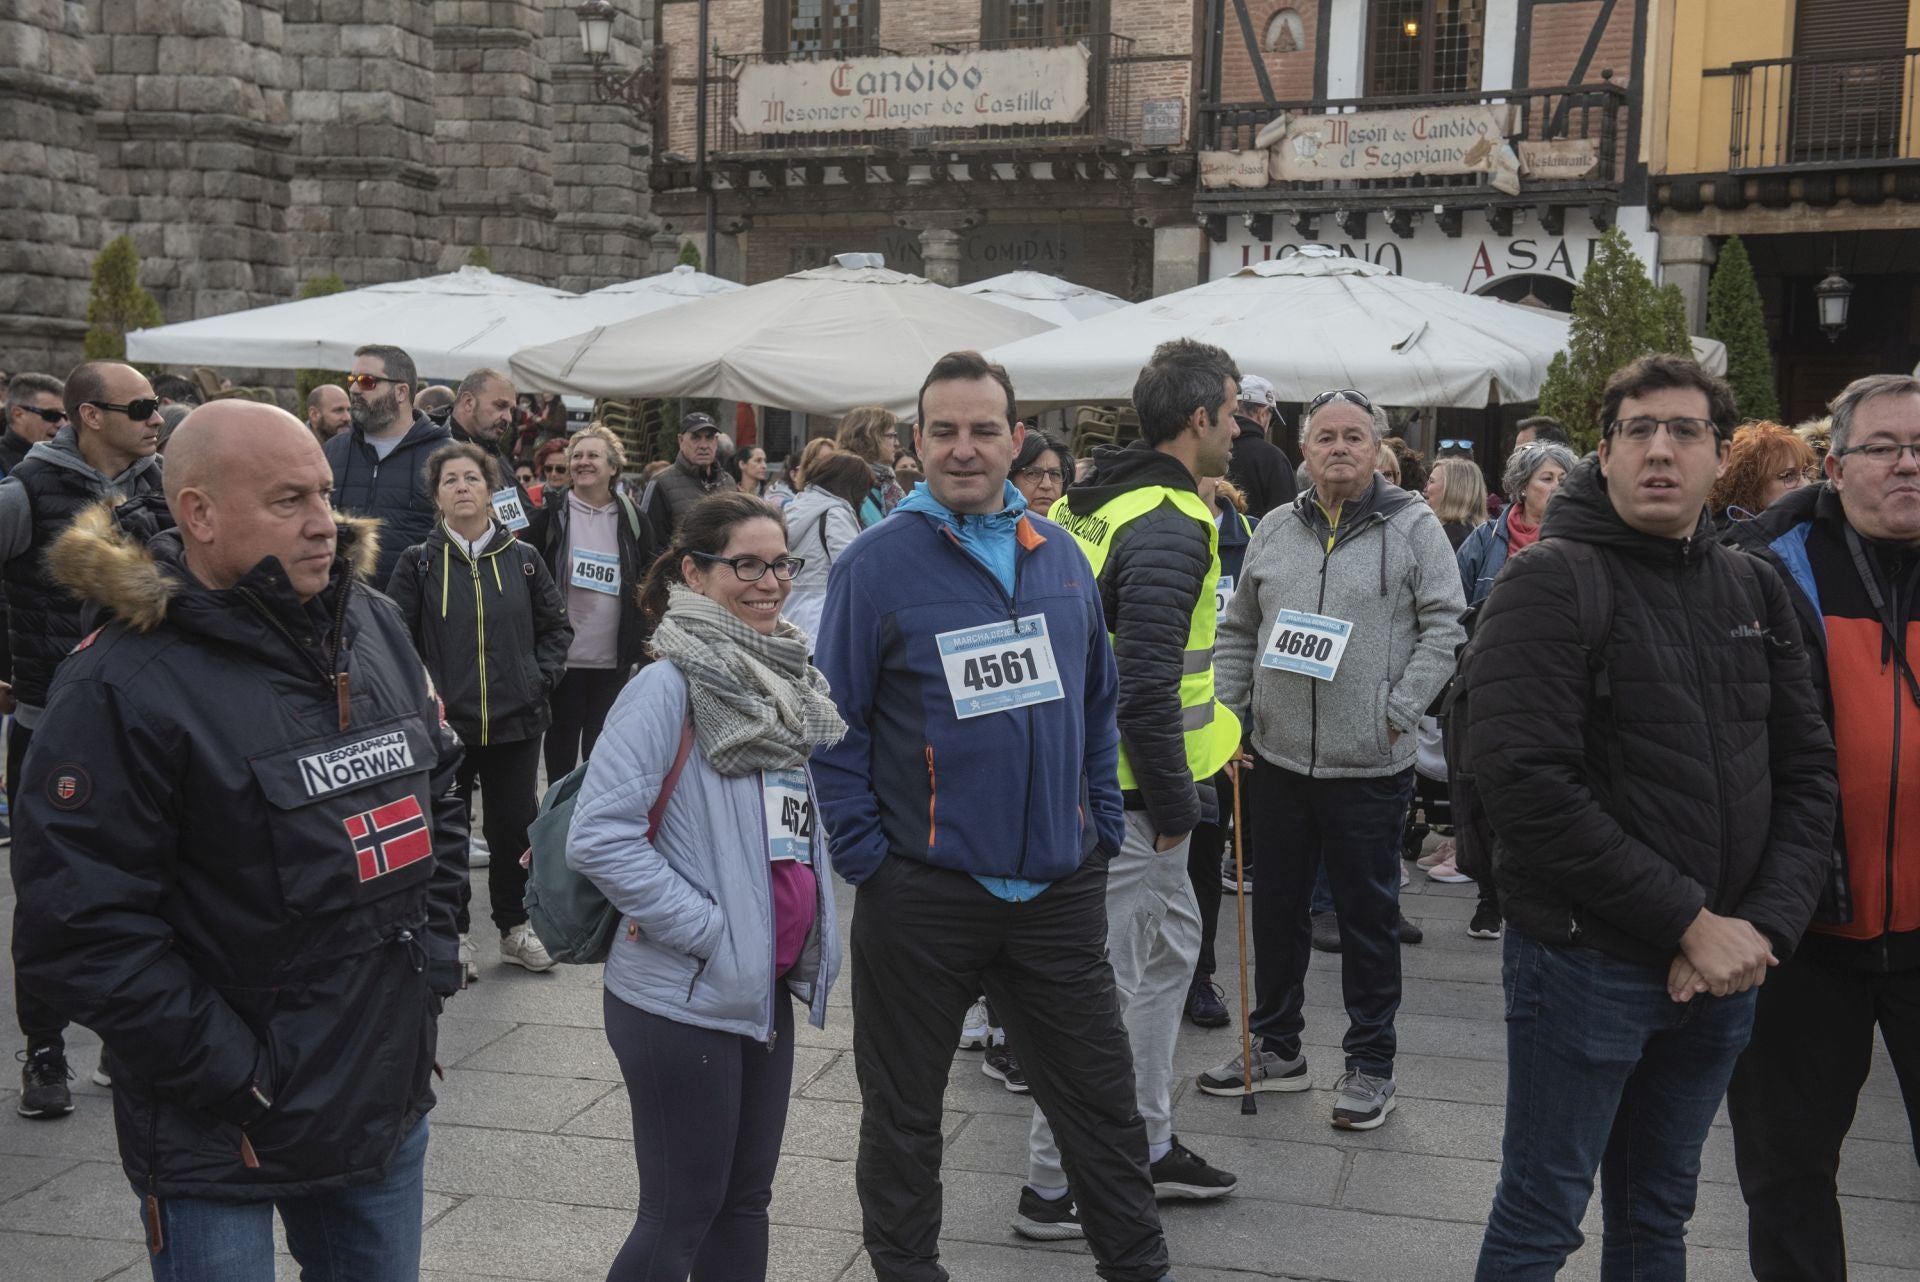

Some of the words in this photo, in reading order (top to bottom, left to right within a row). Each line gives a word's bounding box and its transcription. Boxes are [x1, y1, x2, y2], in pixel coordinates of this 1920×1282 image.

[829, 59, 983, 97] Candido
[761, 99, 861, 124] Mesonero
[863, 97, 933, 123] Mayor
[942, 98, 965, 115] de
[974, 90, 1053, 114] Castilla
[1391, 126, 1408, 142] de
[1412, 114, 1489, 141] Candido
[1339, 149, 1355, 168] el
[1363, 144, 1463, 173] Segoviano
[1525, 152, 1593, 169] Restaurante
[498, 502, 521, 522] 4584
[575, 561, 616, 583] 4586
[953, 631, 990, 647] MARCHA
[1274, 629, 1334, 662] 4680
[963, 647, 1039, 691] 4561
[302, 745, 408, 795] NORWAY
